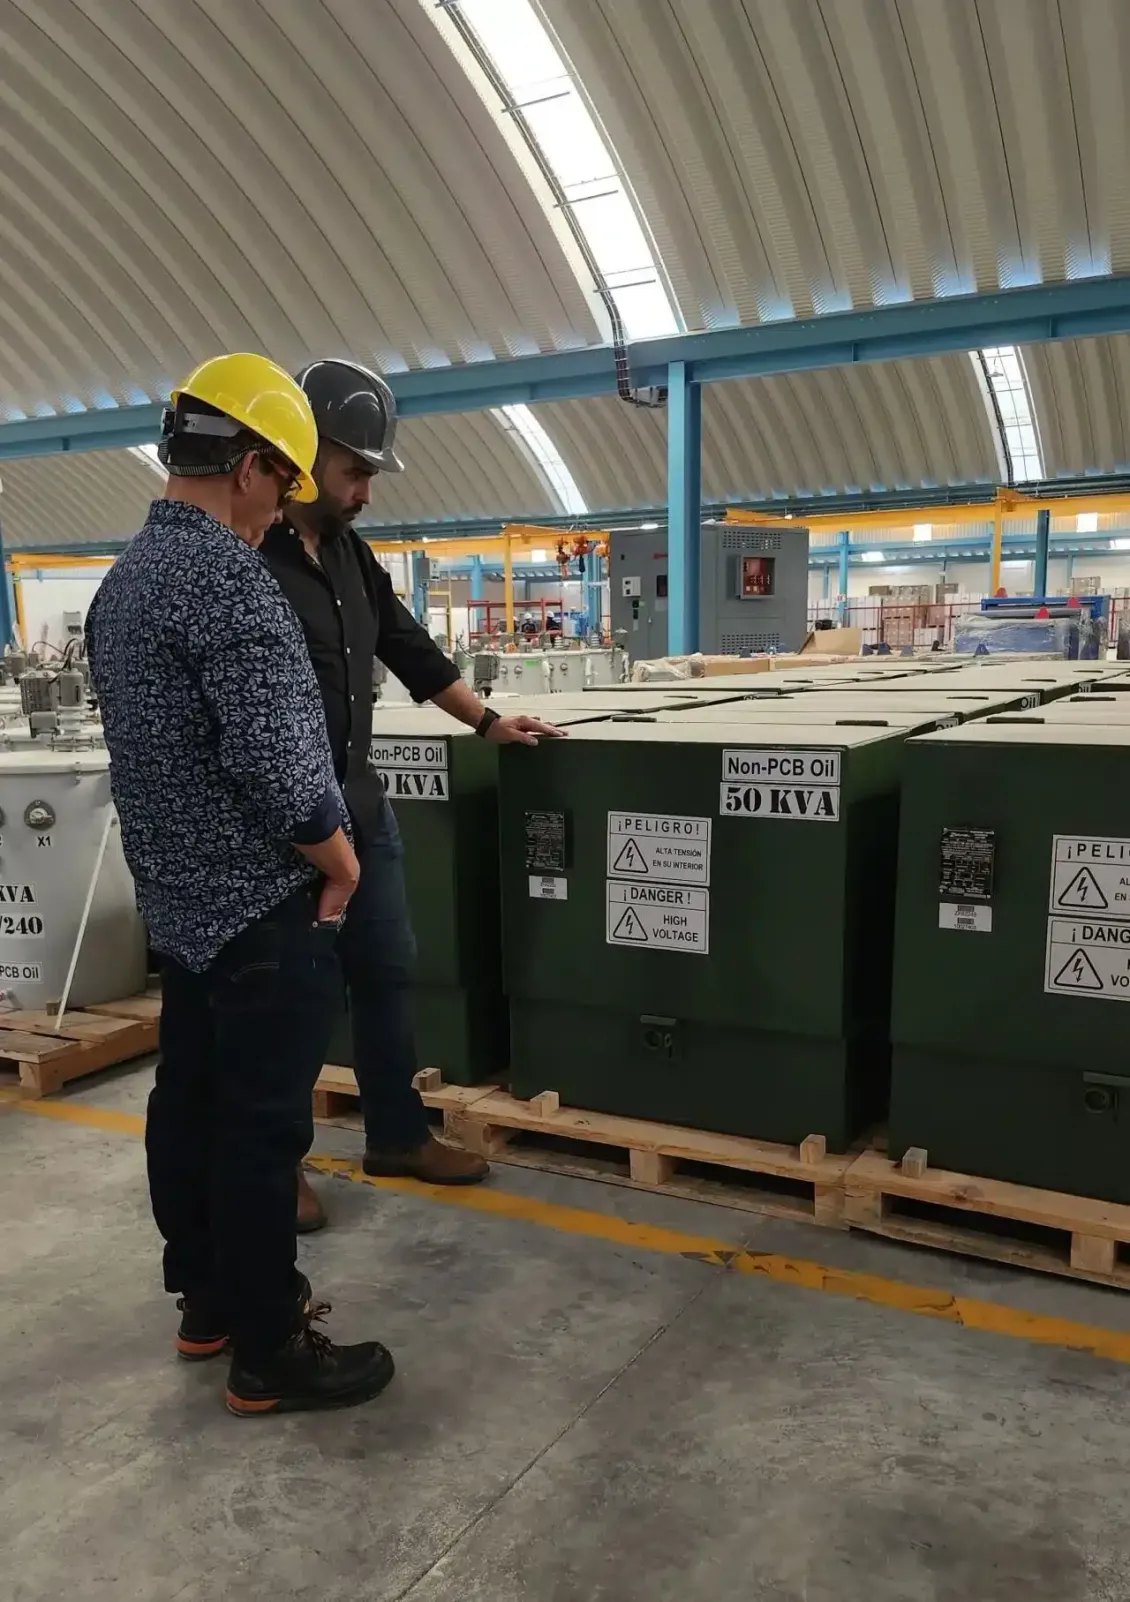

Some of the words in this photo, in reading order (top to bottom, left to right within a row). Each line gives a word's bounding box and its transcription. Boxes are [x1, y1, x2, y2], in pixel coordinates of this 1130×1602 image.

[1020, 696, 1036, 709] Oil
[425, 747, 442, 762] Oil
[728, 757, 804, 776] Non-PCB
[810, 759, 834, 777] Oil
[395, 774, 445, 795] KVA
[726, 787, 761, 812] 50
[769, 789, 835, 816] KVA
[37, 835, 51, 847] X1
[655, 847, 672, 856] ALTA
[1067, 842, 1130, 859] ¡PELI
[652, 859, 662, 868] EN
[663, 860, 672, 868] SU
[673, 861, 704, 871] INTERIOR
[1114, 892, 1127, 902] EN
[663, 914, 688, 927] HIGH
[652, 928, 699, 942] VOLTAGE
[22, 966, 39, 979] Oil
[1110, 973, 1130, 988] VO
